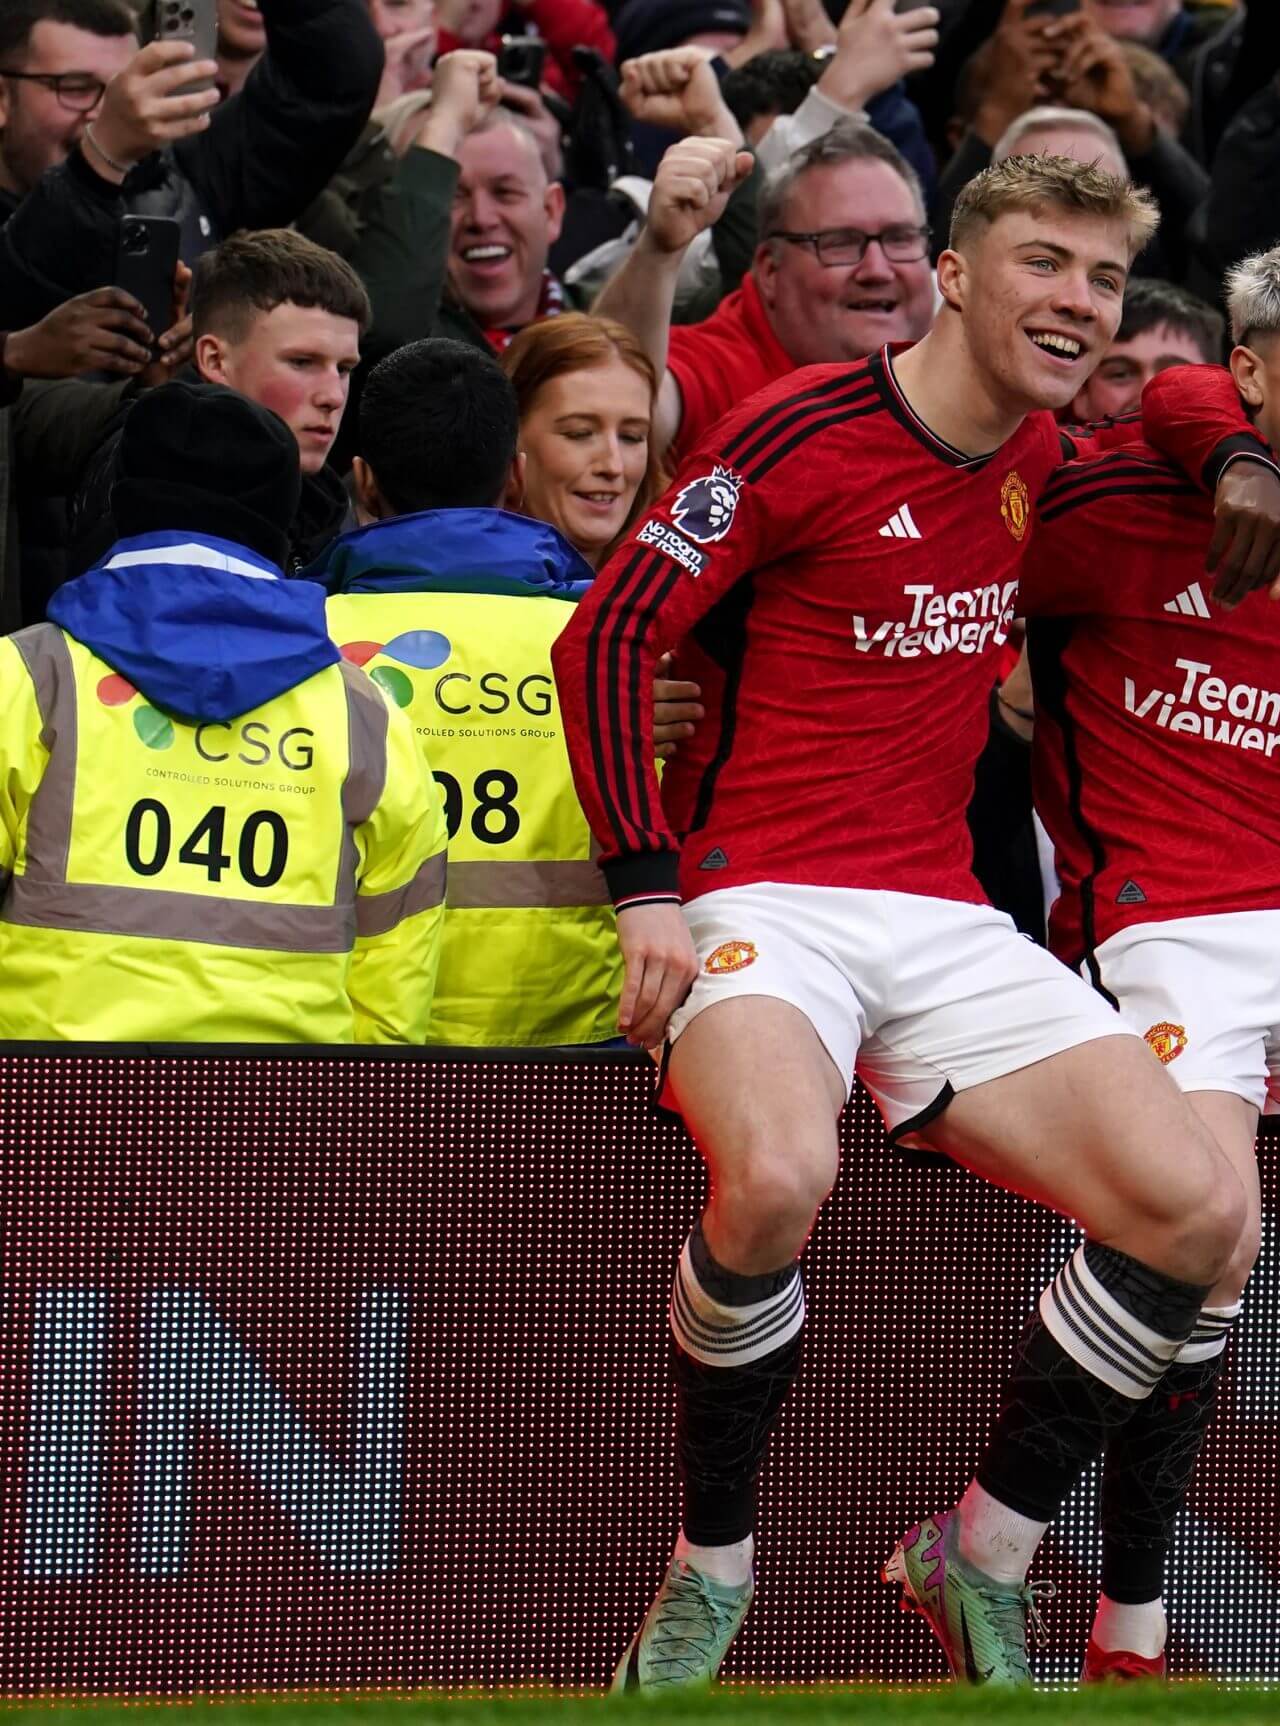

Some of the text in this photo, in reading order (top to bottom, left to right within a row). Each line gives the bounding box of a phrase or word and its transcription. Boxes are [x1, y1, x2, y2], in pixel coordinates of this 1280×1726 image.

[636, 529, 659, 543] for
[642, 520, 702, 564] No room
[904, 583, 1000, 629] Team
[853, 615, 995, 658] Viewer
[434, 672, 552, 716] CSG
[195, 722, 314, 770] CSG
[459, 728, 516, 737] SOLUTIONS
[520, 729, 556, 738] GROUP
[146, 768, 317, 795] CONTROLLED SOLUTIONS GROUP
[126, 798, 289, 888] 040
[24, 1290, 407, 1576] IN
